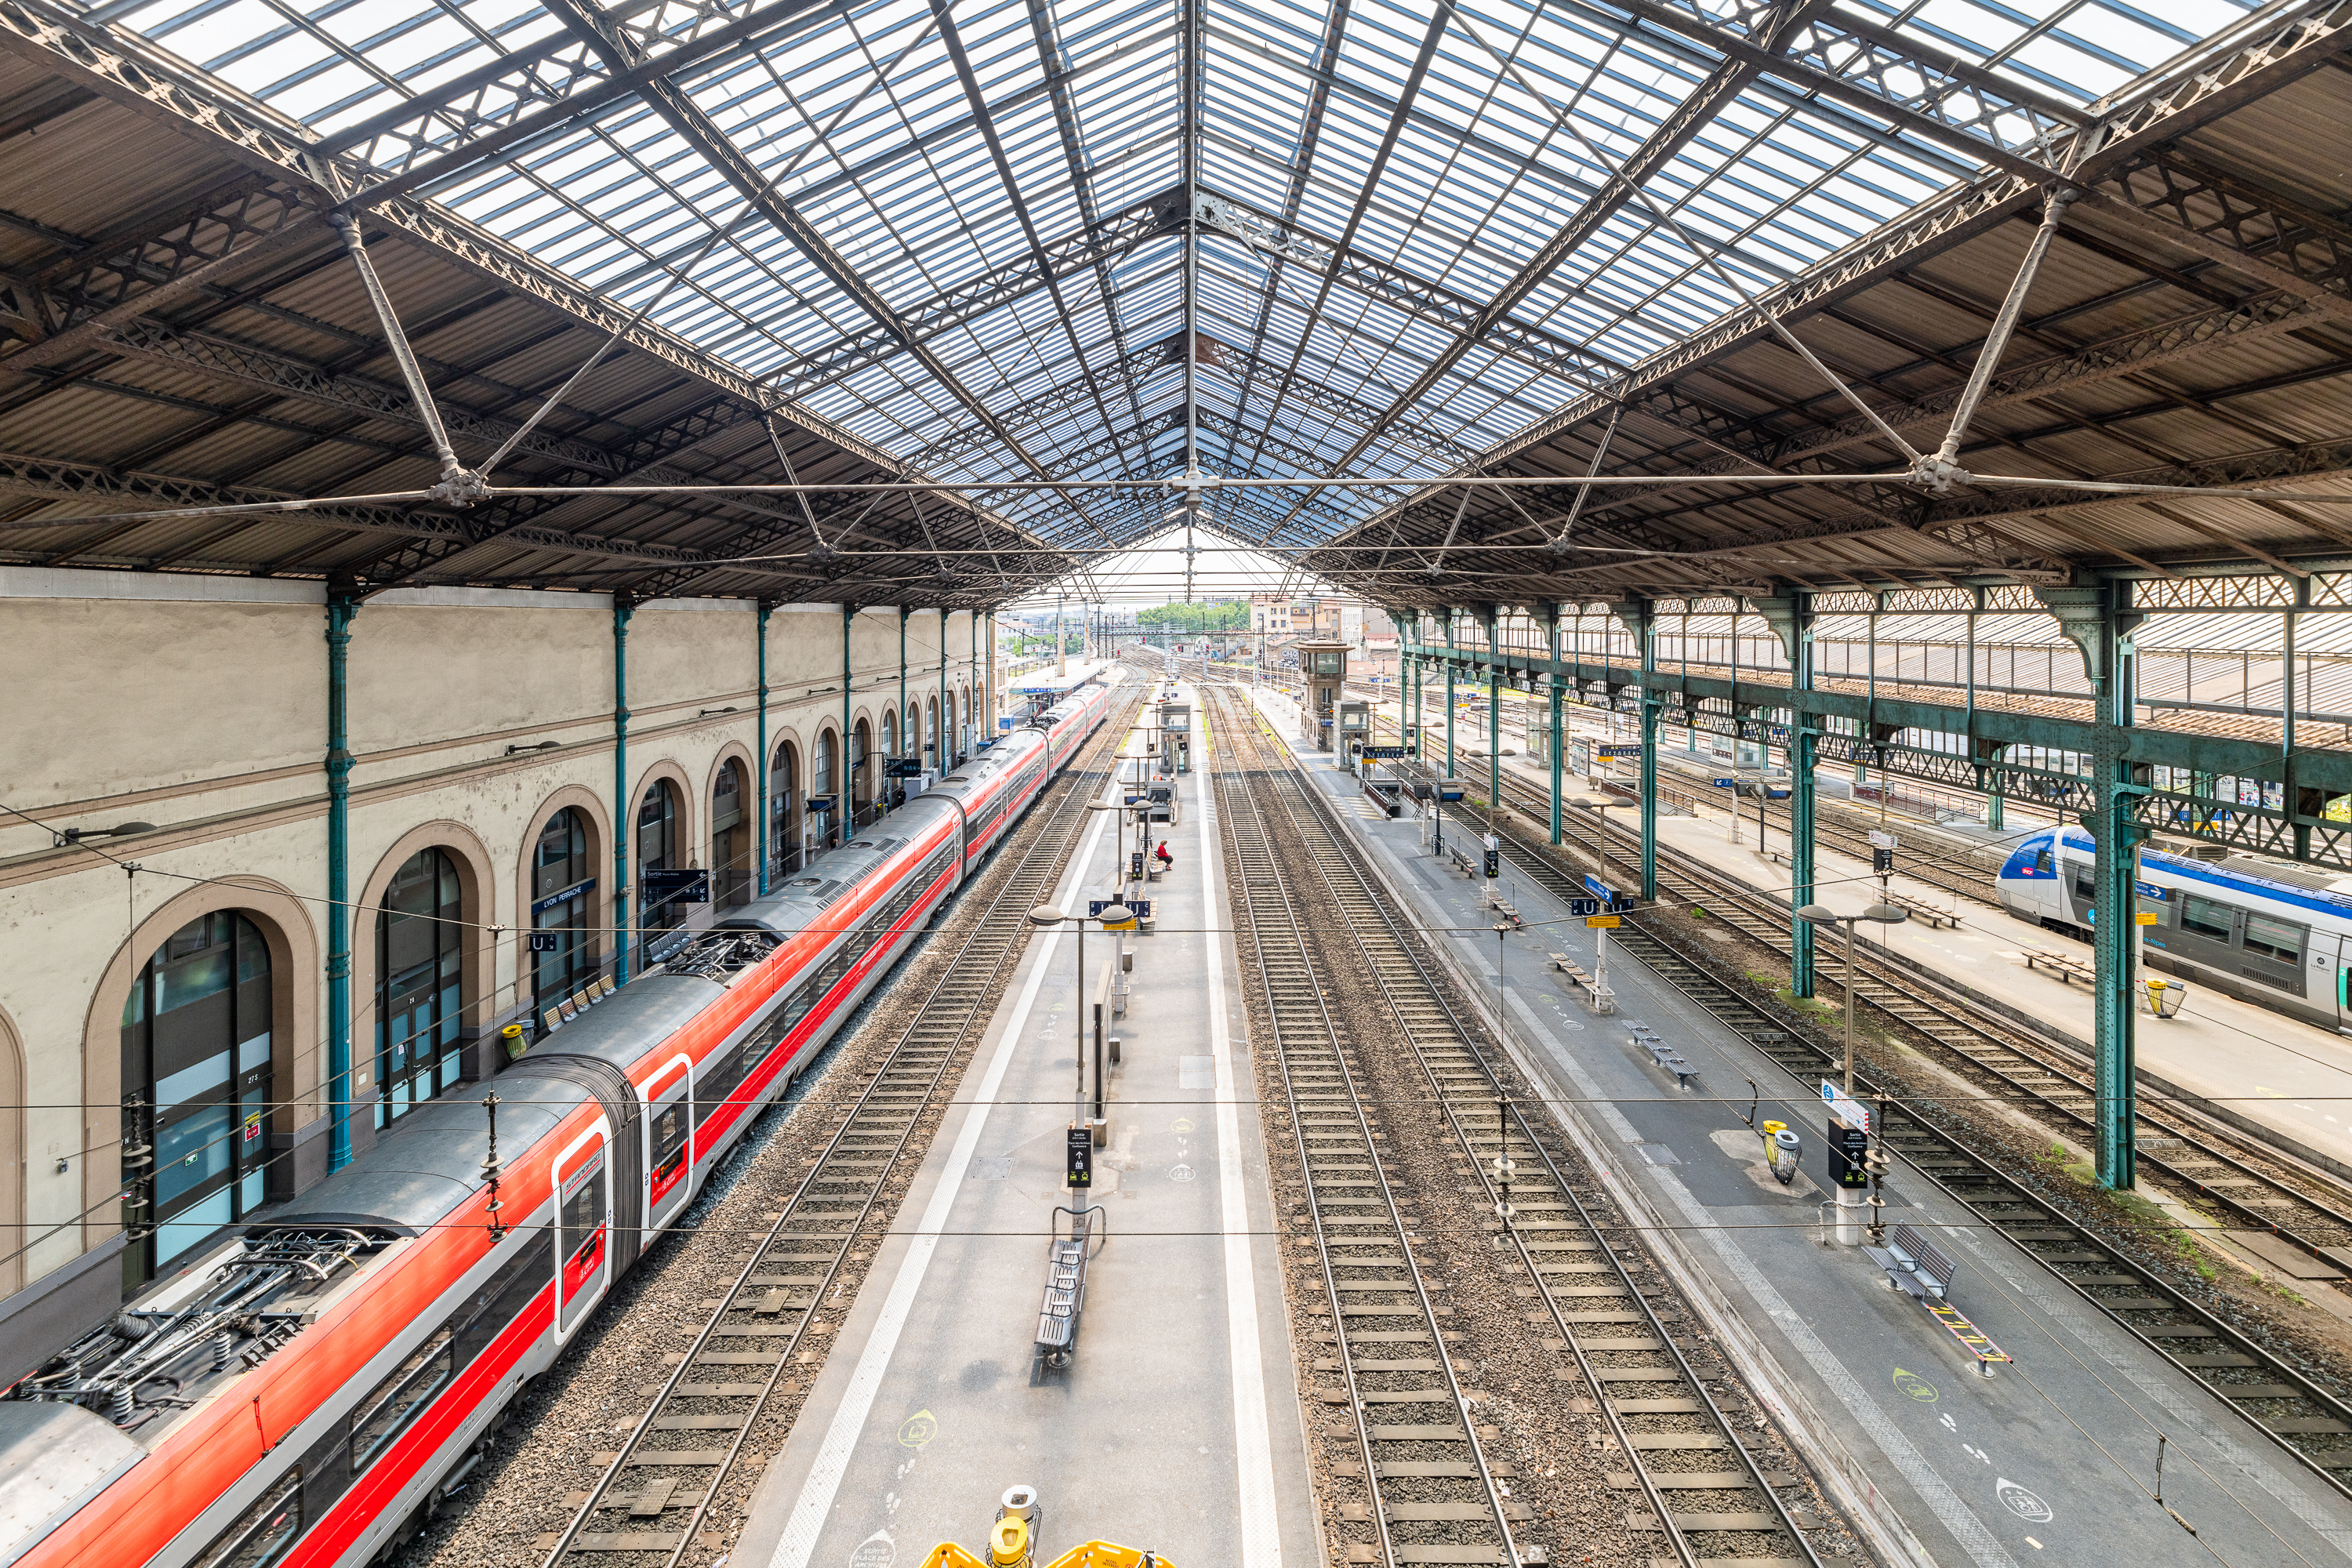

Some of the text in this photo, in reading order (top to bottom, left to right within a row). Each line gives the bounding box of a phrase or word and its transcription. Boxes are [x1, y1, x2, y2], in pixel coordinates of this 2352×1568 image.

[544, 886, 581, 907] LYON PERRACHE
[1584, 902, 1594, 914] U
[534, 937, 543, 950] U
[566, 1153, 600, 1190] STANDARD
